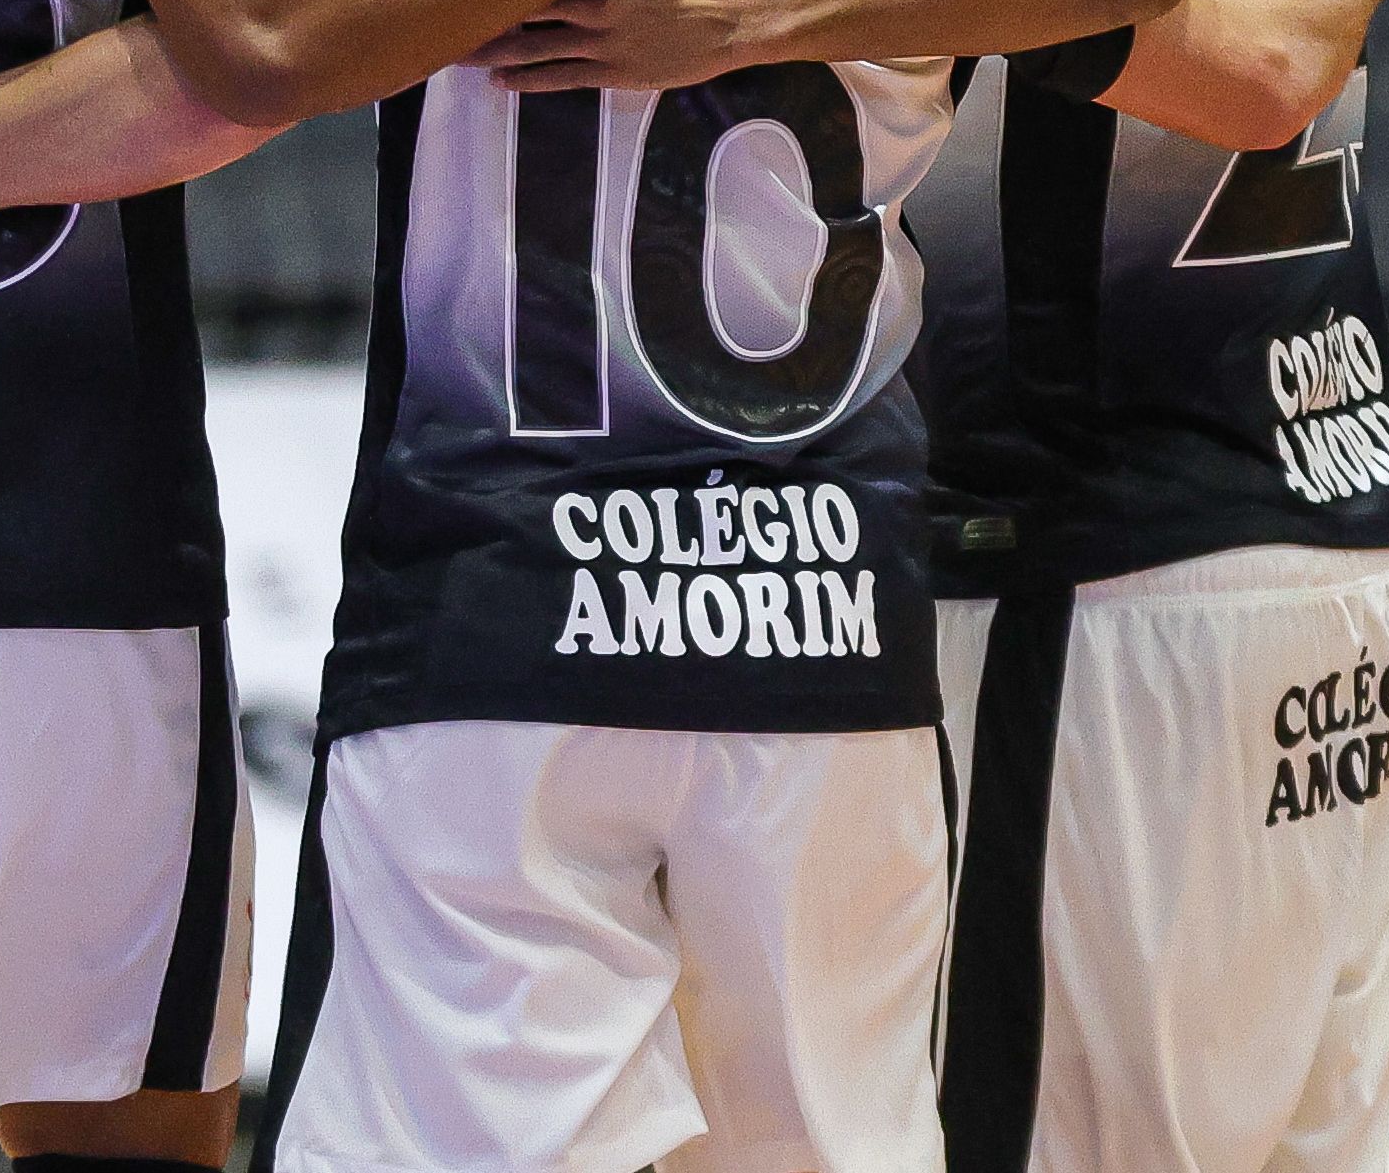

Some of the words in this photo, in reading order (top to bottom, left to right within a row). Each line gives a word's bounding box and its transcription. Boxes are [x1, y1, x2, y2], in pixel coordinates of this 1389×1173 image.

[505, 60, 886, 444] 10
[551, 470, 861, 568] COLÉGIO
[553, 566, 882, 659] AMORIM
